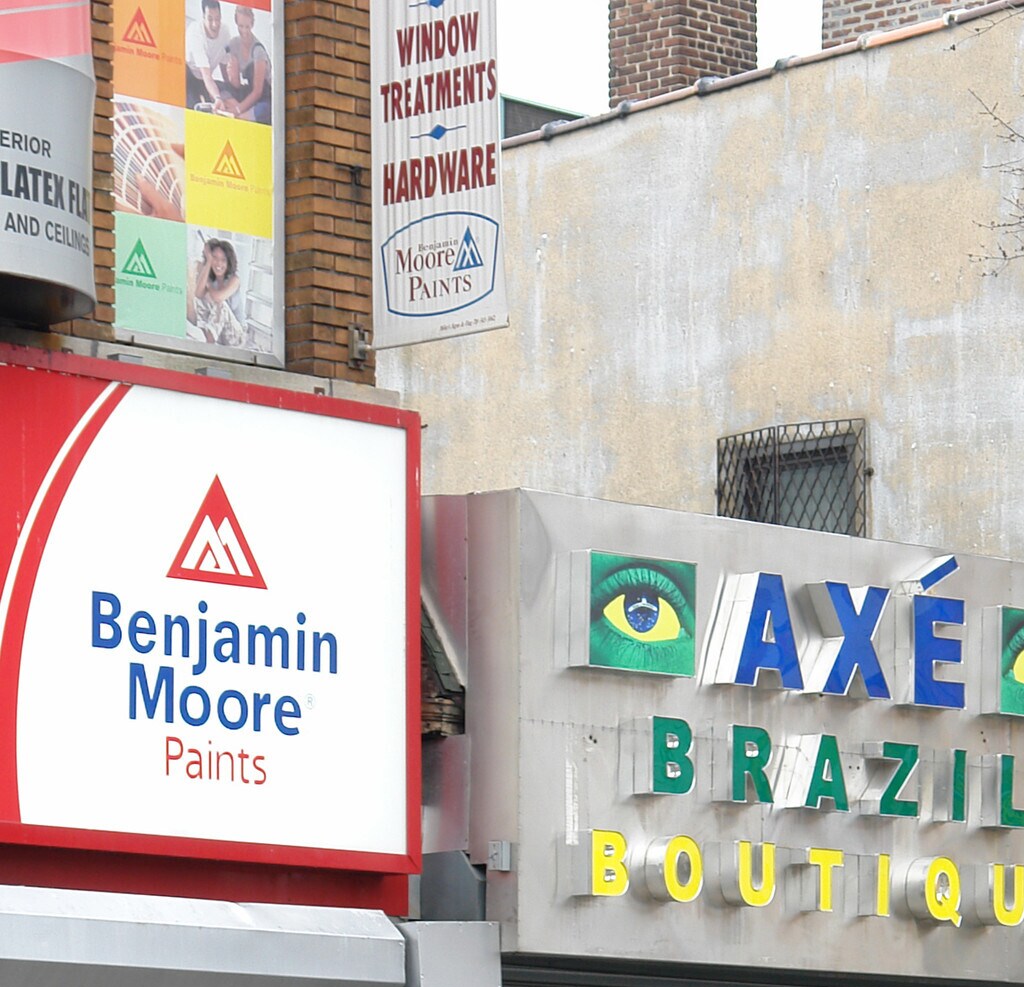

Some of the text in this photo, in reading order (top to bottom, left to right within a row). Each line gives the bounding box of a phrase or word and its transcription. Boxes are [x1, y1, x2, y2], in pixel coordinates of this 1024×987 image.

[396, 11, 479, 68] WINDOW
[380, 58, 497, 123] TREATMENTS
[0, 130, 51, 158] ERIOR
[1, 161, 65, 211] LATEX
[383, 142, 496, 206] HARDWARE
[5, 212, 40, 237] AND
[418, 239, 458, 252] Benjamin
[395, 246, 455, 275] Moore
[409, 274, 472, 302] PAINTS
[92, 590, 338, 676] Benjamin
[733, 554, 966, 709] AXÉ
[129, 663, 302, 736] Moore
[166, 736, 267, 785] Paints
